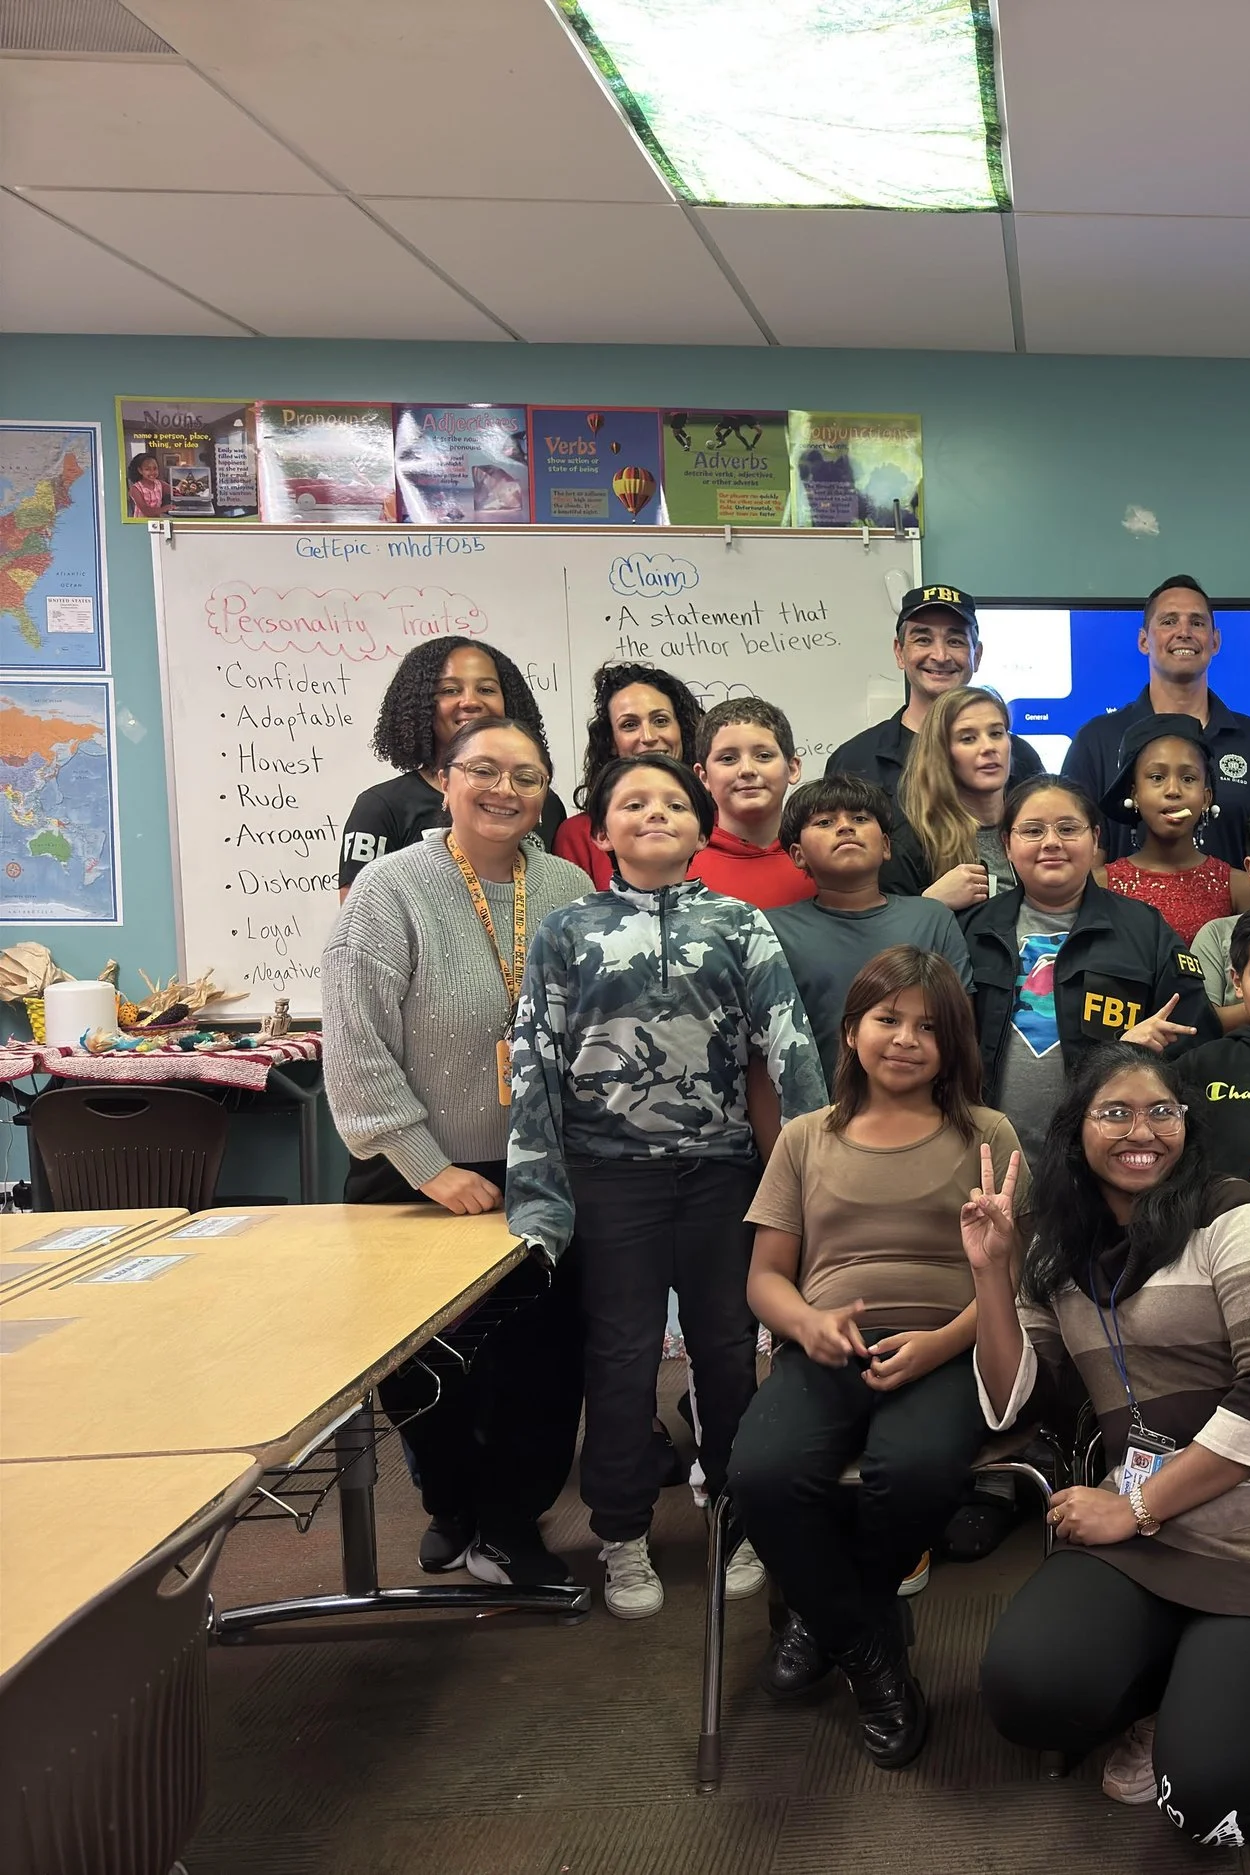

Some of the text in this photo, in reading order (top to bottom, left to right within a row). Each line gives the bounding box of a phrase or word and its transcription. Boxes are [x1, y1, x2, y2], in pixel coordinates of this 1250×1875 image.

[143, 410, 203, 429] Nouns
[422, 412, 519, 434] Adjectives
[148, 441, 172, 449] thing,
[160, 433, 188, 442] person,
[189, 432, 212, 442] place,
[544, 436, 597, 455] Verbs
[579, 466, 599, 474] being
[694, 452, 768, 470] Adverbs
[388, 534, 486, 558] mhd7055
[617, 561, 688, 589] Claim
[923, 587, 961, 605] FBI
[223, 594, 470, 653] Personality Traits
[618, 600, 829, 631] A statement that
[616, 629, 842, 658] the author believes.
[225, 661, 352, 695] Confident
[237, 702, 353, 742] Adaptable
[1024, 713, 1049, 721] General
[238, 743, 324, 776] Honest
[237, 783, 300, 810] Rude
[236, 815, 339, 858] Arrogant
[343, 831, 388, 863] FBI
[237, 869, 341, 896] Dishones
[247, 916, 302, 956] Loyal
[251, 963, 322, 992] Negative
[1177, 953, 1203, 975] FBI
[1083, 991, 1142, 1031] FBI
